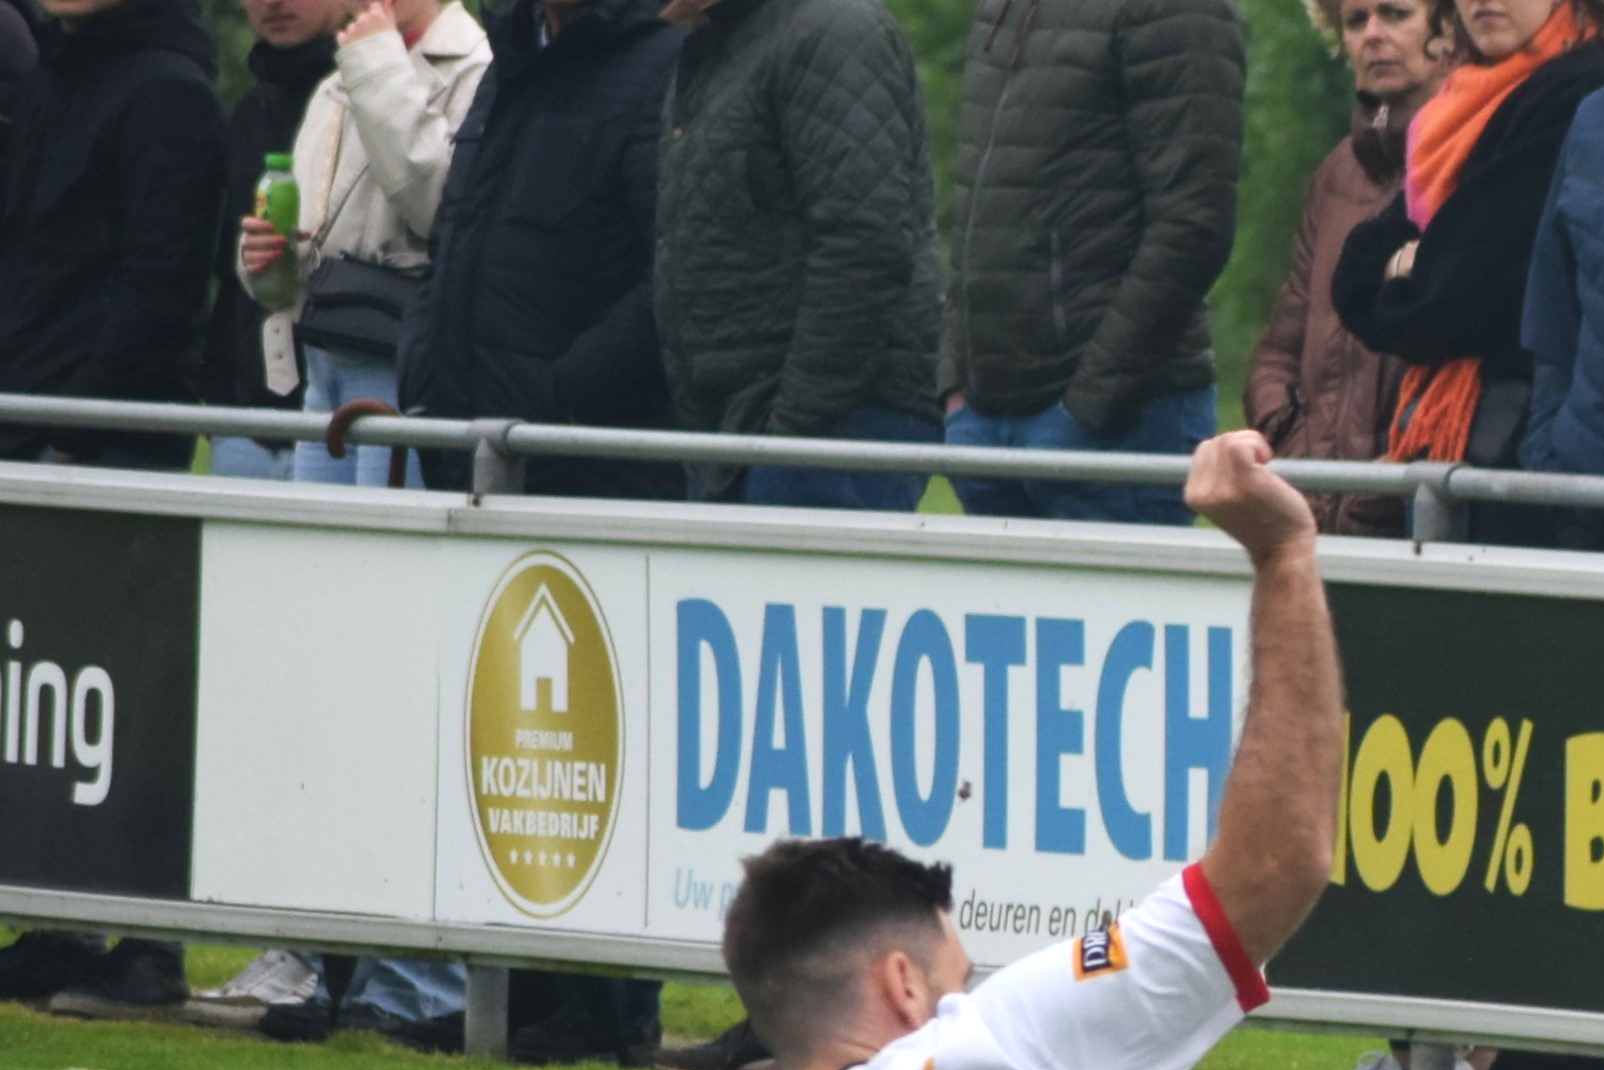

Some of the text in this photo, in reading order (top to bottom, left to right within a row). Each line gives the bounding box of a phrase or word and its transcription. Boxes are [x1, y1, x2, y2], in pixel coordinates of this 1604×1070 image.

[515, 729, 574, 751] PREMIUM
[676, 597, 1233, 862] DAKOTECH
[481, 756, 607, 803] KOZIJNEN
[488, 807, 600, 840] VAKBEDRIJF
[674, 867, 714, 910] Uw
[959, 888, 1042, 934] deuren
[1049, 905, 1077, 938] en
